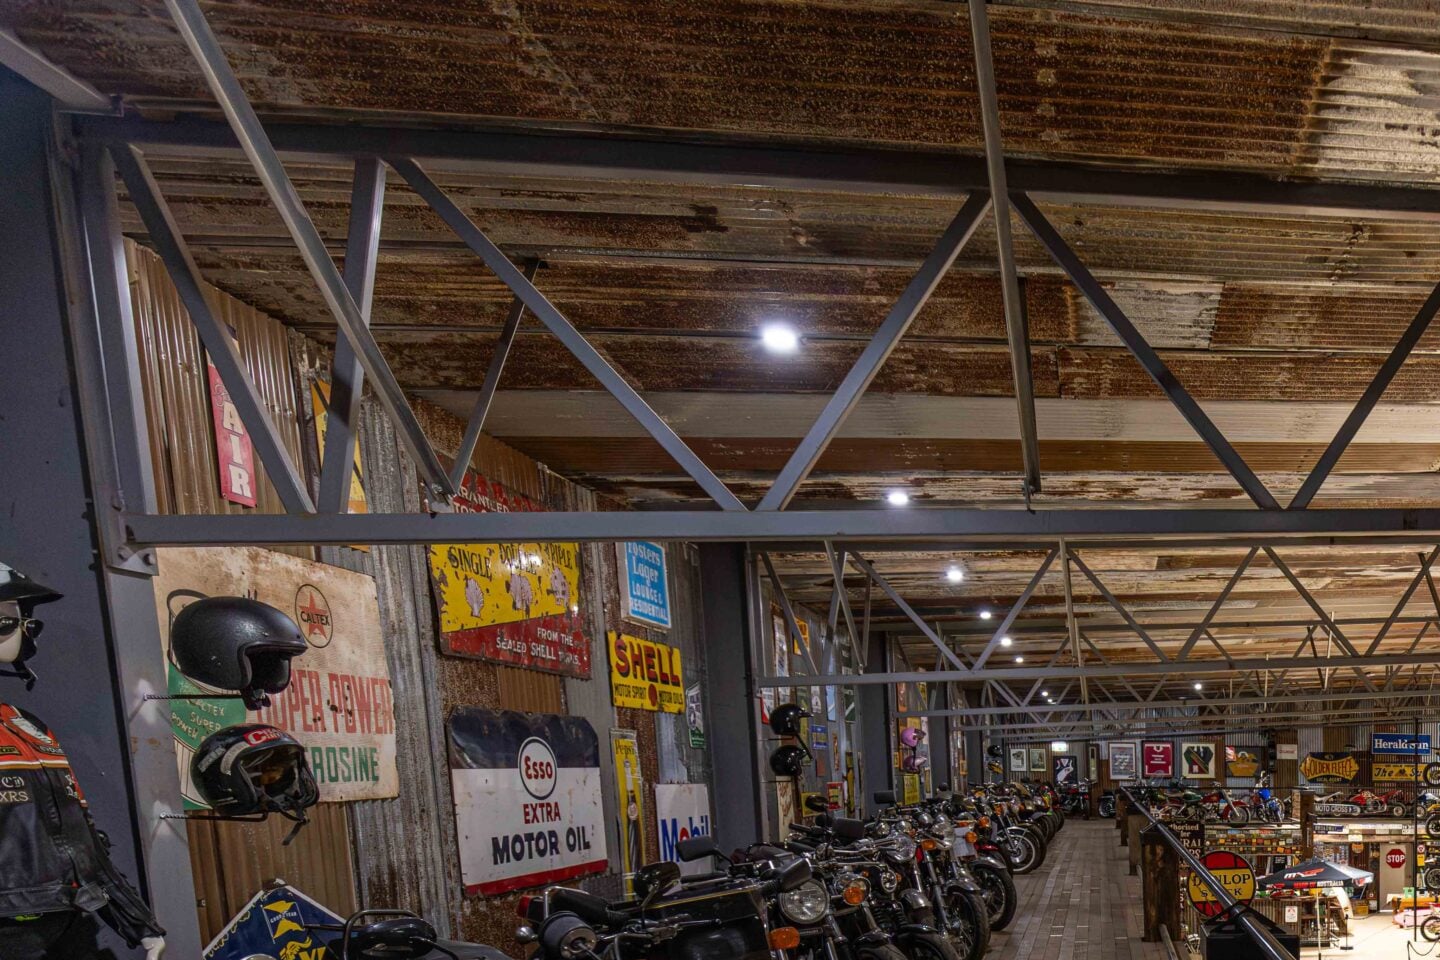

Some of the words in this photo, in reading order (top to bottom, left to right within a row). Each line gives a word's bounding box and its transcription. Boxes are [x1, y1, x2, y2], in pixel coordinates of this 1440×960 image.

[223, 401, 252, 498] AIR
[448, 545, 493, 579] SINGLE
[300, 610, 330, 626] CALTEX
[537, 627, 559, 642] FROM
[560, 633, 573, 646] THE
[530, 643, 556, 660] SHELL
[615, 639, 680, 686] SHELL
[329, 673, 394, 734] POWER
[1375, 739, 1407, 749] Herald
[305, 747, 379, 783] ROSINE
[524, 755, 553, 780] Esso
[1304, 757, 1331, 778] GOLDEN
[1332, 758, 1353, 777] FLEECE
[1374, 767, 1393, 777] The
[523, 802, 561, 824] EXTRA
[492, 830, 560, 865] MOTOR
[566, 826, 590, 852] OIL
[1387, 855, 1405, 863] STOP
[1193, 874, 1250, 886] DNLOP
